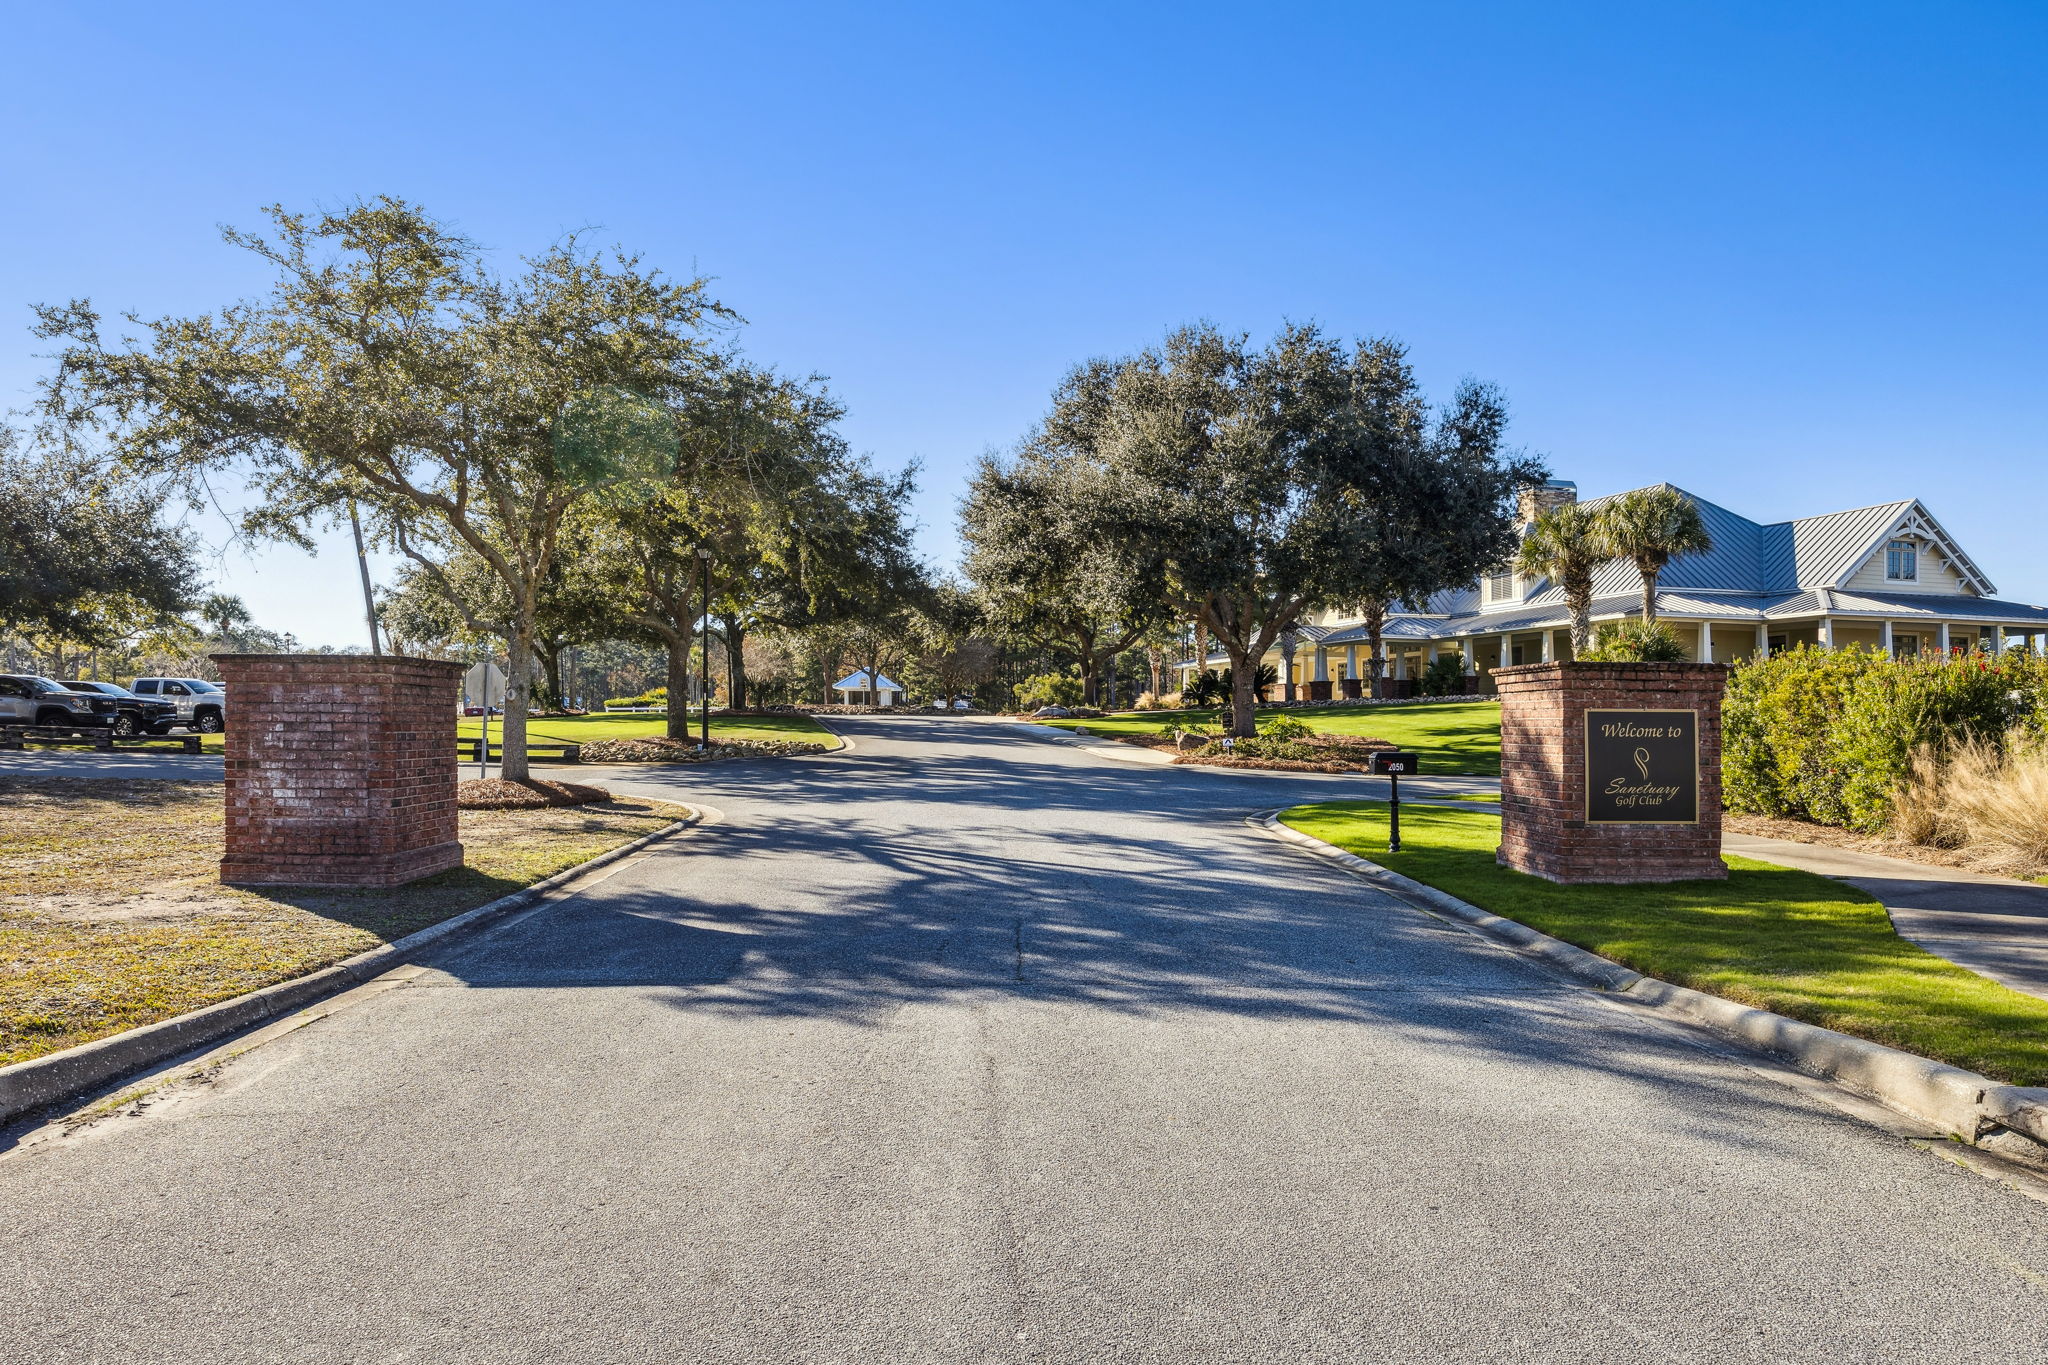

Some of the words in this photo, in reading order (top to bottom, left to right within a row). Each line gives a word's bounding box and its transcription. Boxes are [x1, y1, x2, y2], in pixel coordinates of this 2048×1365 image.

[1601, 722, 1664, 738] Welcome
[1668, 726, 1682, 738] to
[1604, 777, 1680, 801] Sanctuary
[1615, 794, 1638, 808] Golf
[1639, 795, 1663, 806] Club
